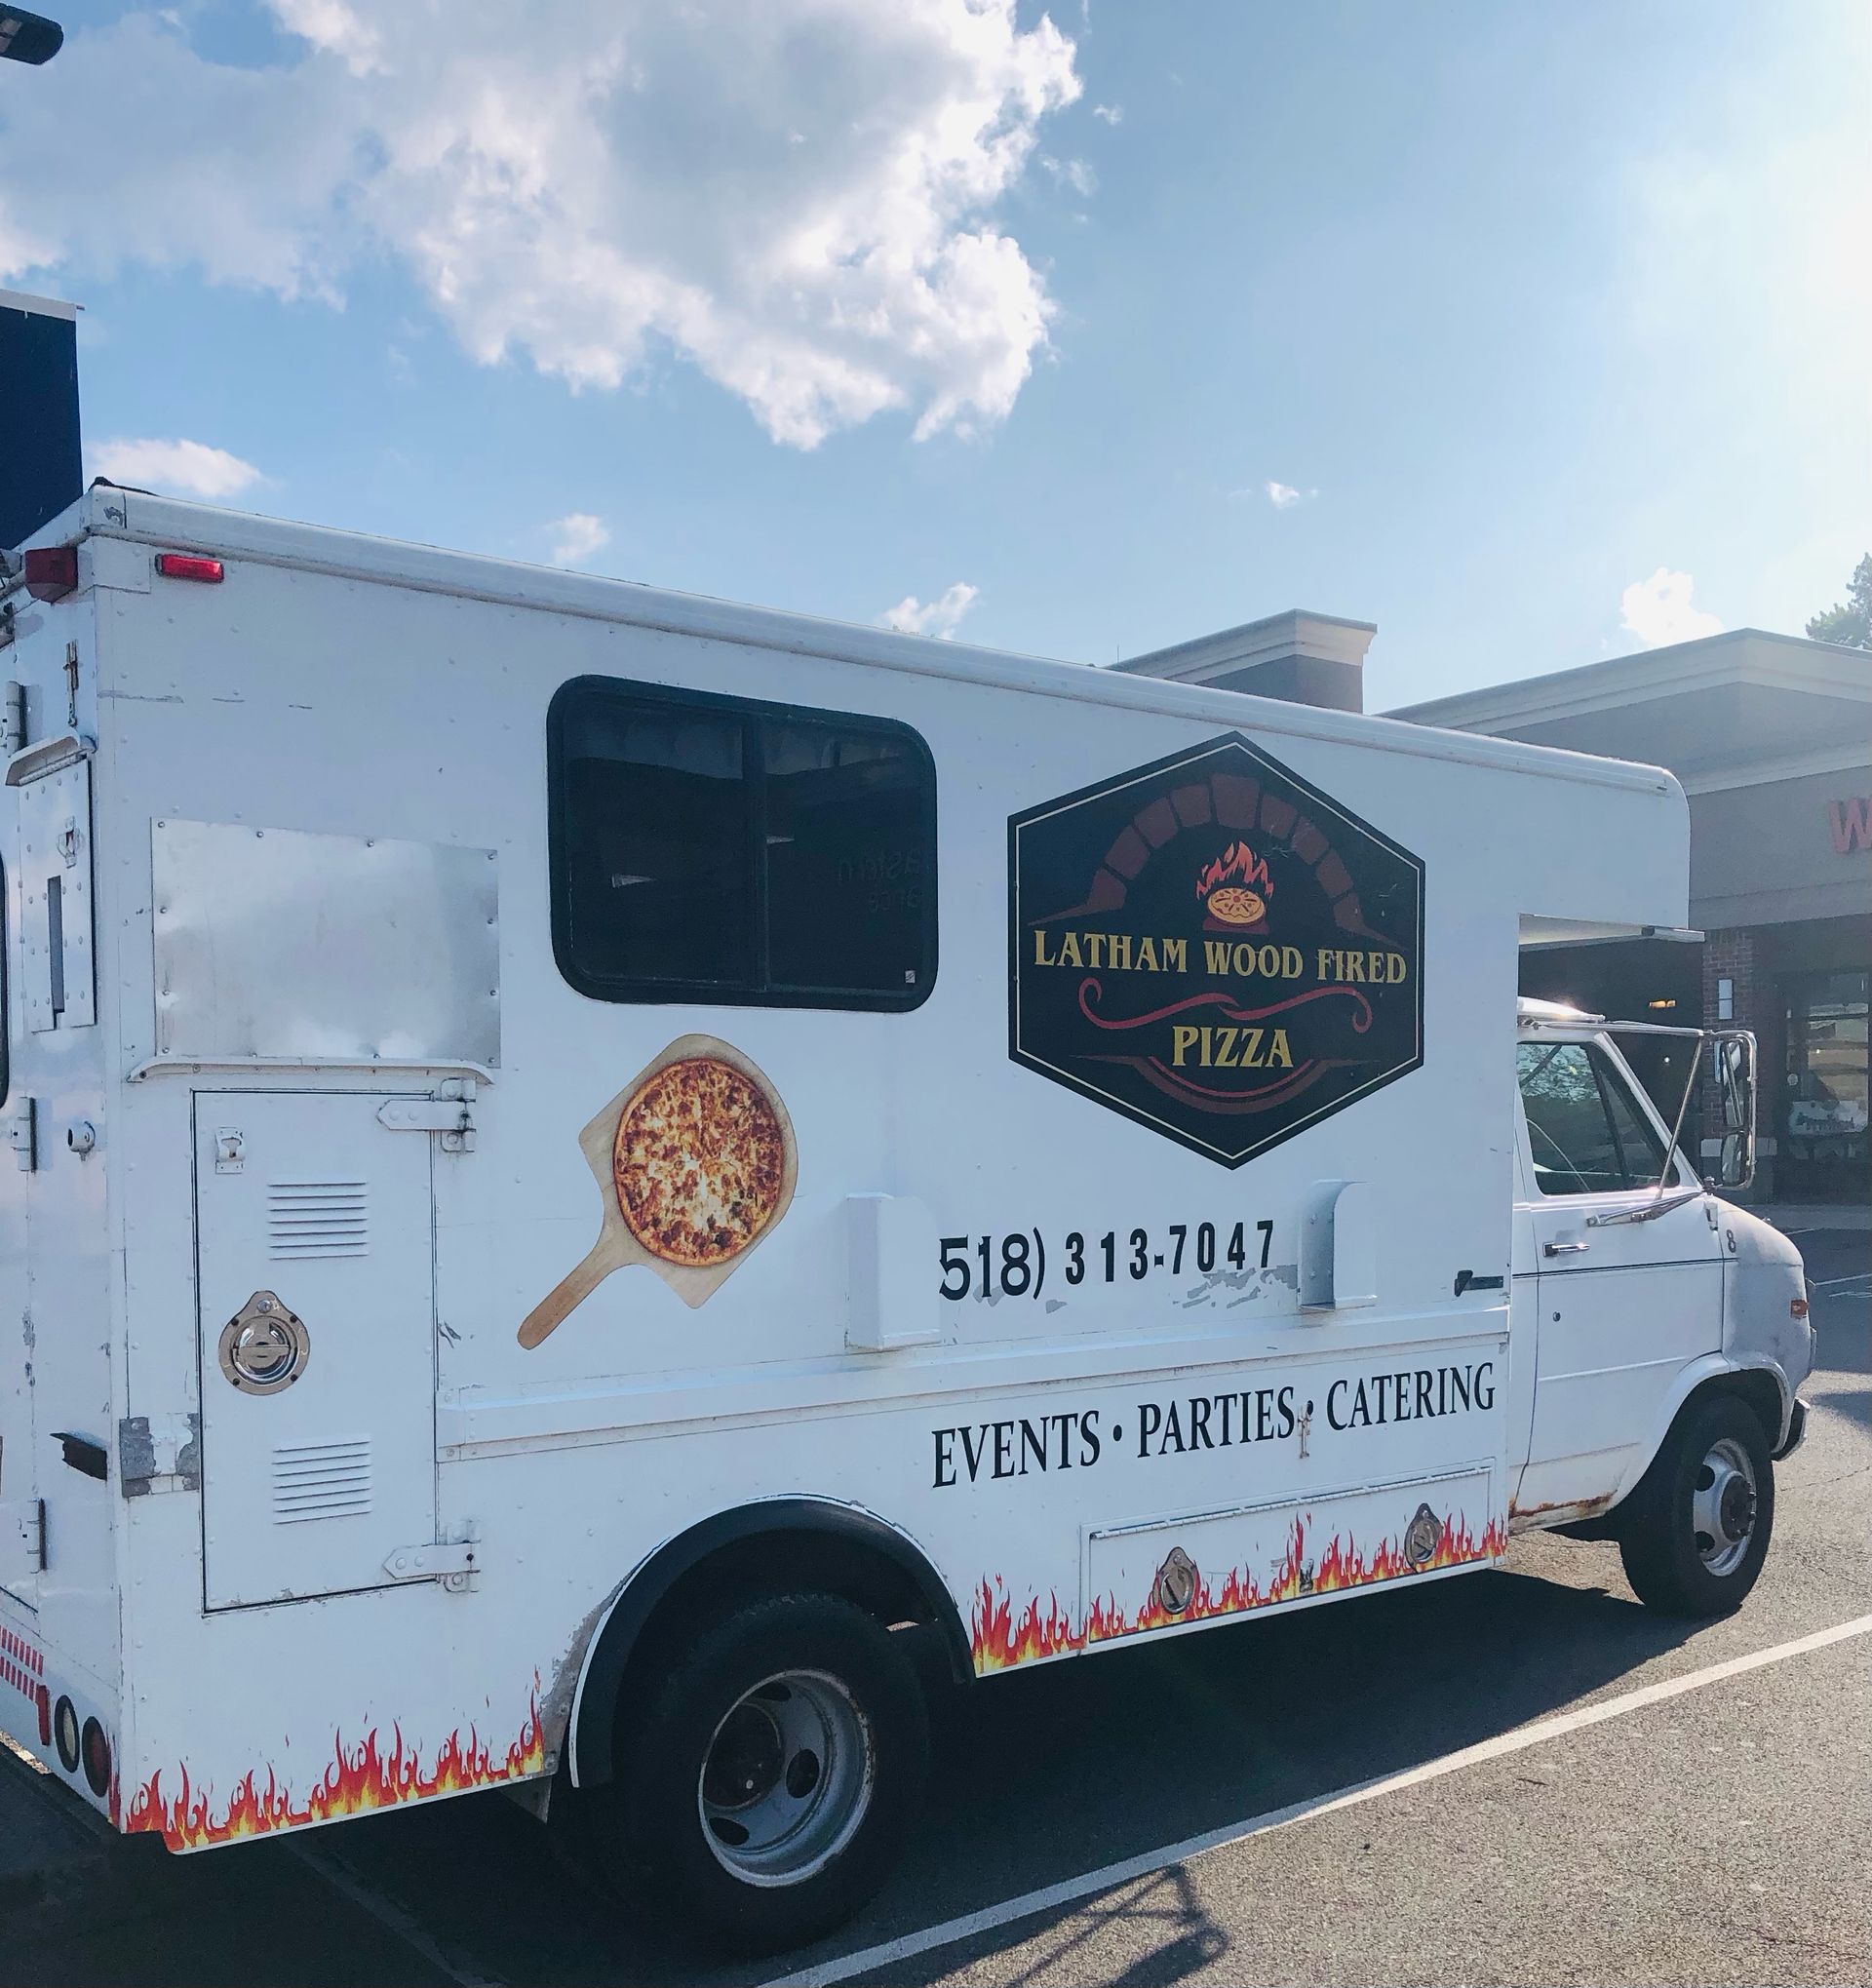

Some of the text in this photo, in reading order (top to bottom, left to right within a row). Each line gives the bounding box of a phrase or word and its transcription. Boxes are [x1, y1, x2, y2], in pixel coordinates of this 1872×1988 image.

[1034, 930, 1408, 985] LATHAM WOOD FIRED
[1172, 1025, 1294, 1069] PIZZA
[938, 1220, 1274, 1302] 518) 313-7047
[1726, 1228, 1736, 1253] 8
[931, 1362, 1497, 1488] EVENTS PARTIES CATERING
